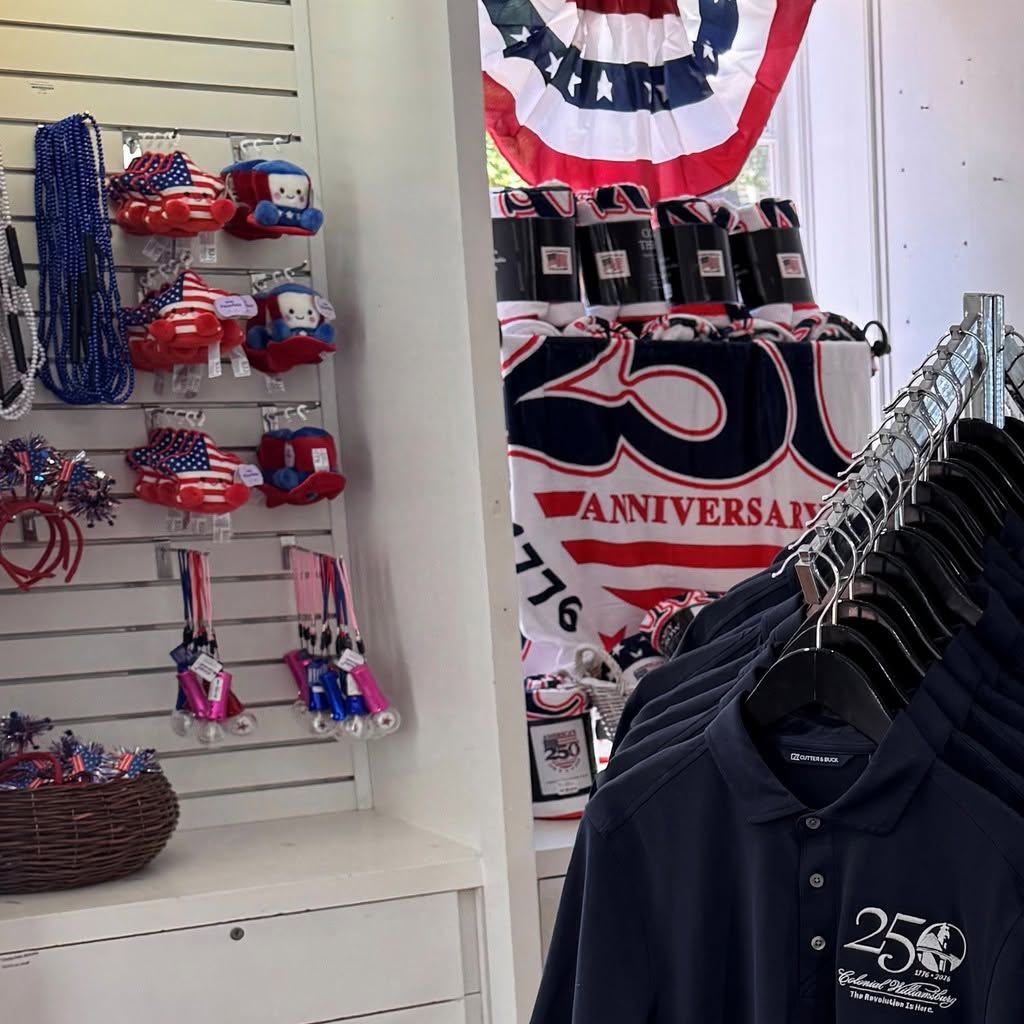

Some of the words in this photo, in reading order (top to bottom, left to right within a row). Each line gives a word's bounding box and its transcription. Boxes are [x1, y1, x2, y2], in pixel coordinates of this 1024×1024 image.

[580, 492, 826, 530] ANNIVERSARY
[513, 523, 583, 632] 776
[545, 743, 581, 761] 250
[843, 906, 967, 973] 250
[838, 968, 891, 990] Colonial
[887, 980, 957, 1008] Williamsburg
[850, 991, 863, 999] The
[864, 994, 905, 1008] Revolution
[914, 1003, 934, 1013] Here.
